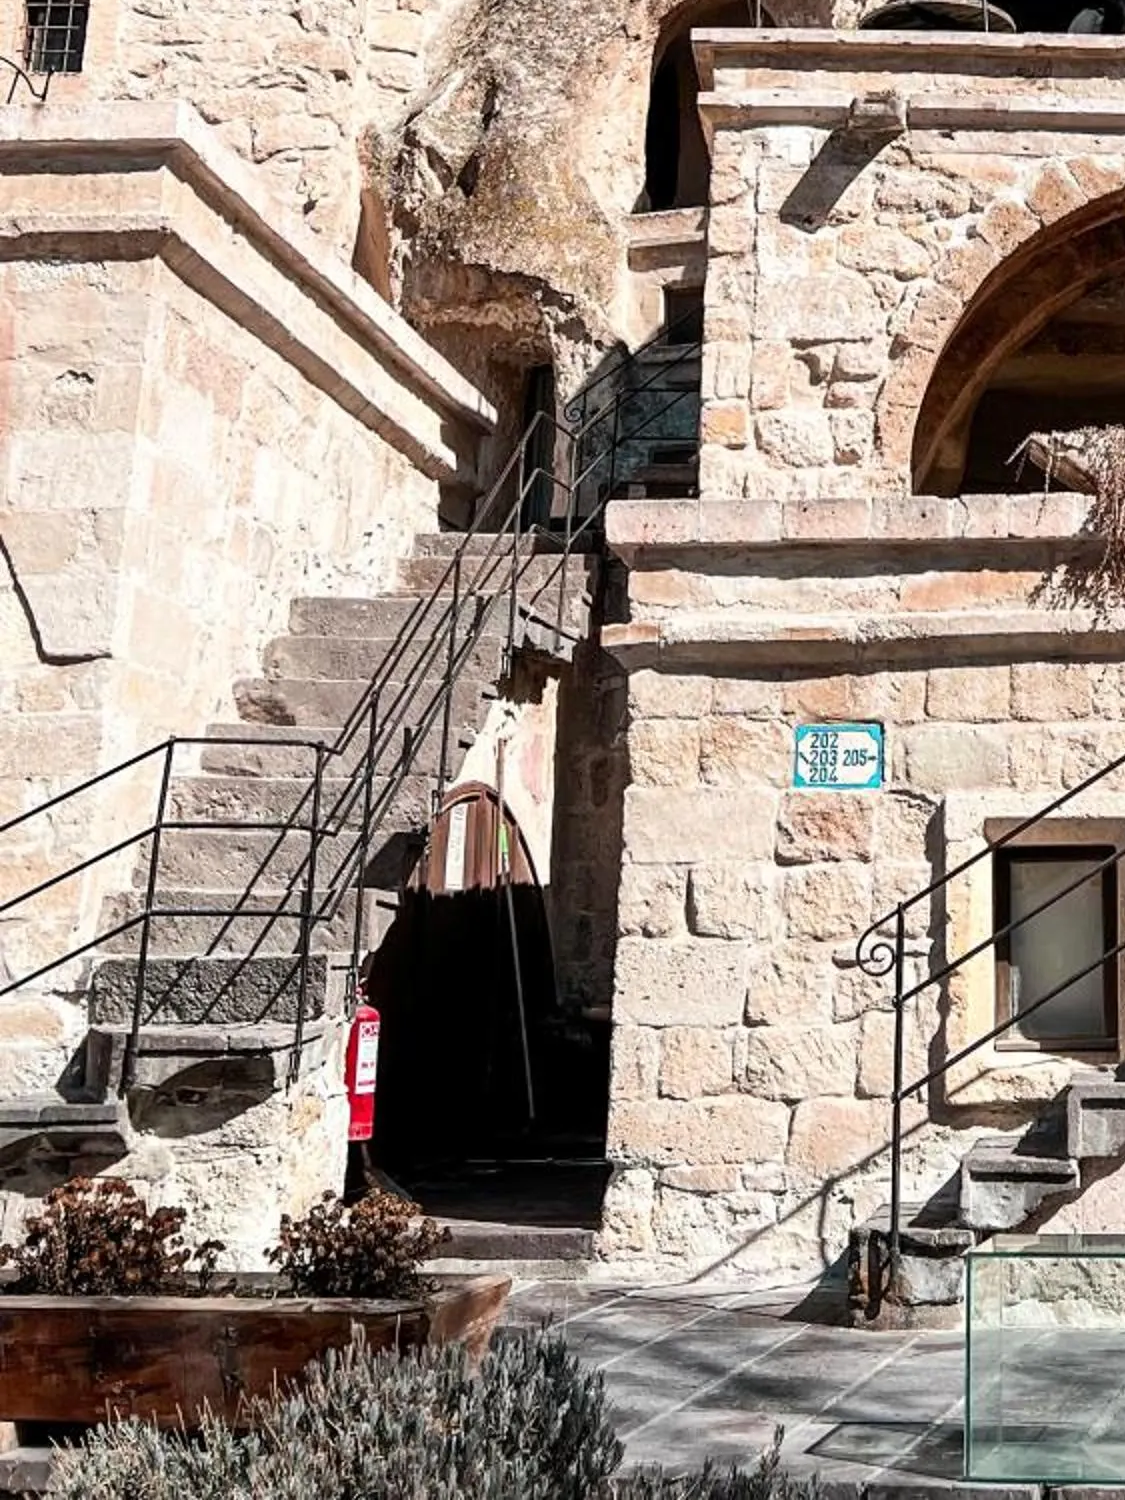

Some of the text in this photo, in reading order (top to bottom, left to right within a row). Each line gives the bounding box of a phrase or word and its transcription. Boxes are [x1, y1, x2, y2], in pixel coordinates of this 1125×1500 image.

[810, 733, 839, 749] 202
[809, 749, 838, 766] 203
[809, 767, 838, 783] 204
